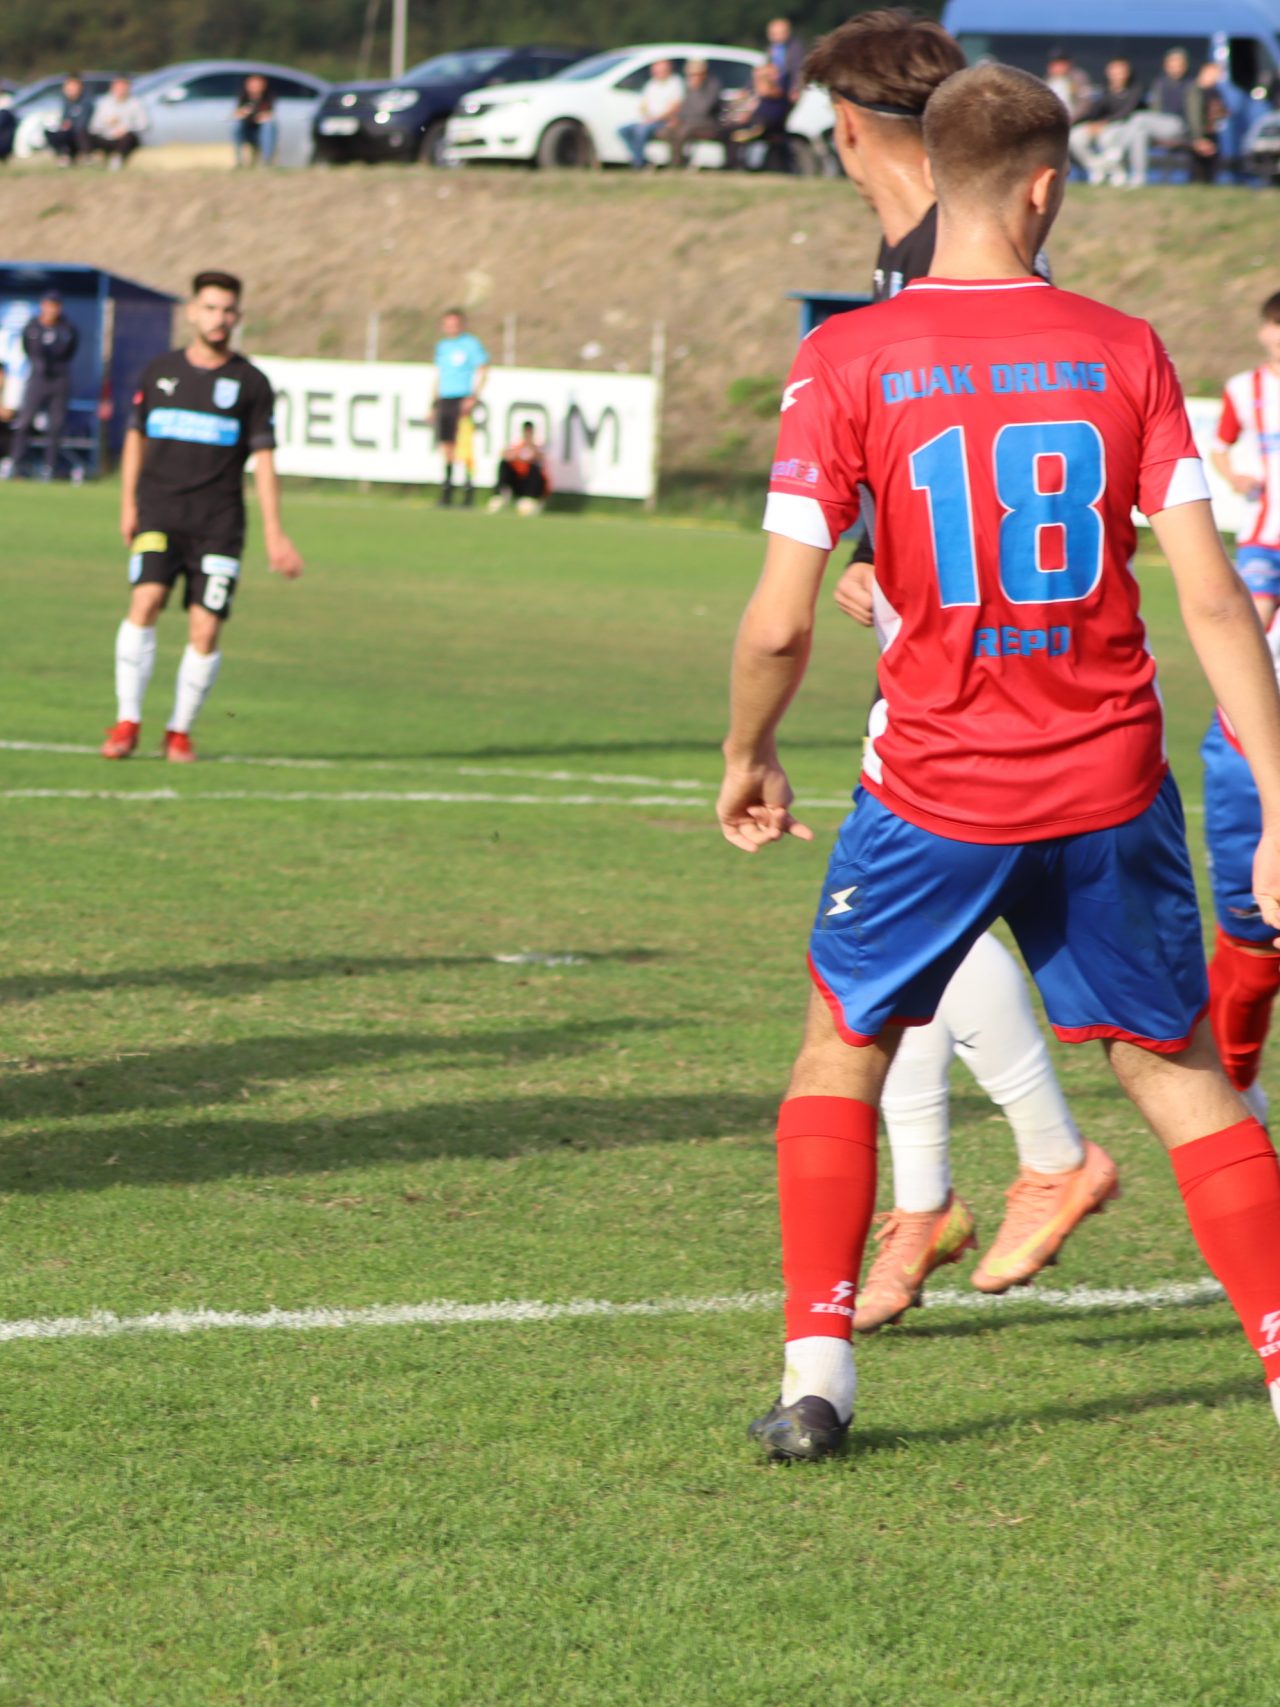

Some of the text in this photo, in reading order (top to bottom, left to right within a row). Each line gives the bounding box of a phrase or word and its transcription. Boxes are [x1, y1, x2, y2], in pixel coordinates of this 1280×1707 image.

[989, 361, 1107, 393] DRUMS
[909, 420, 1107, 608] 18
[973, 625, 1071, 657] REPO
